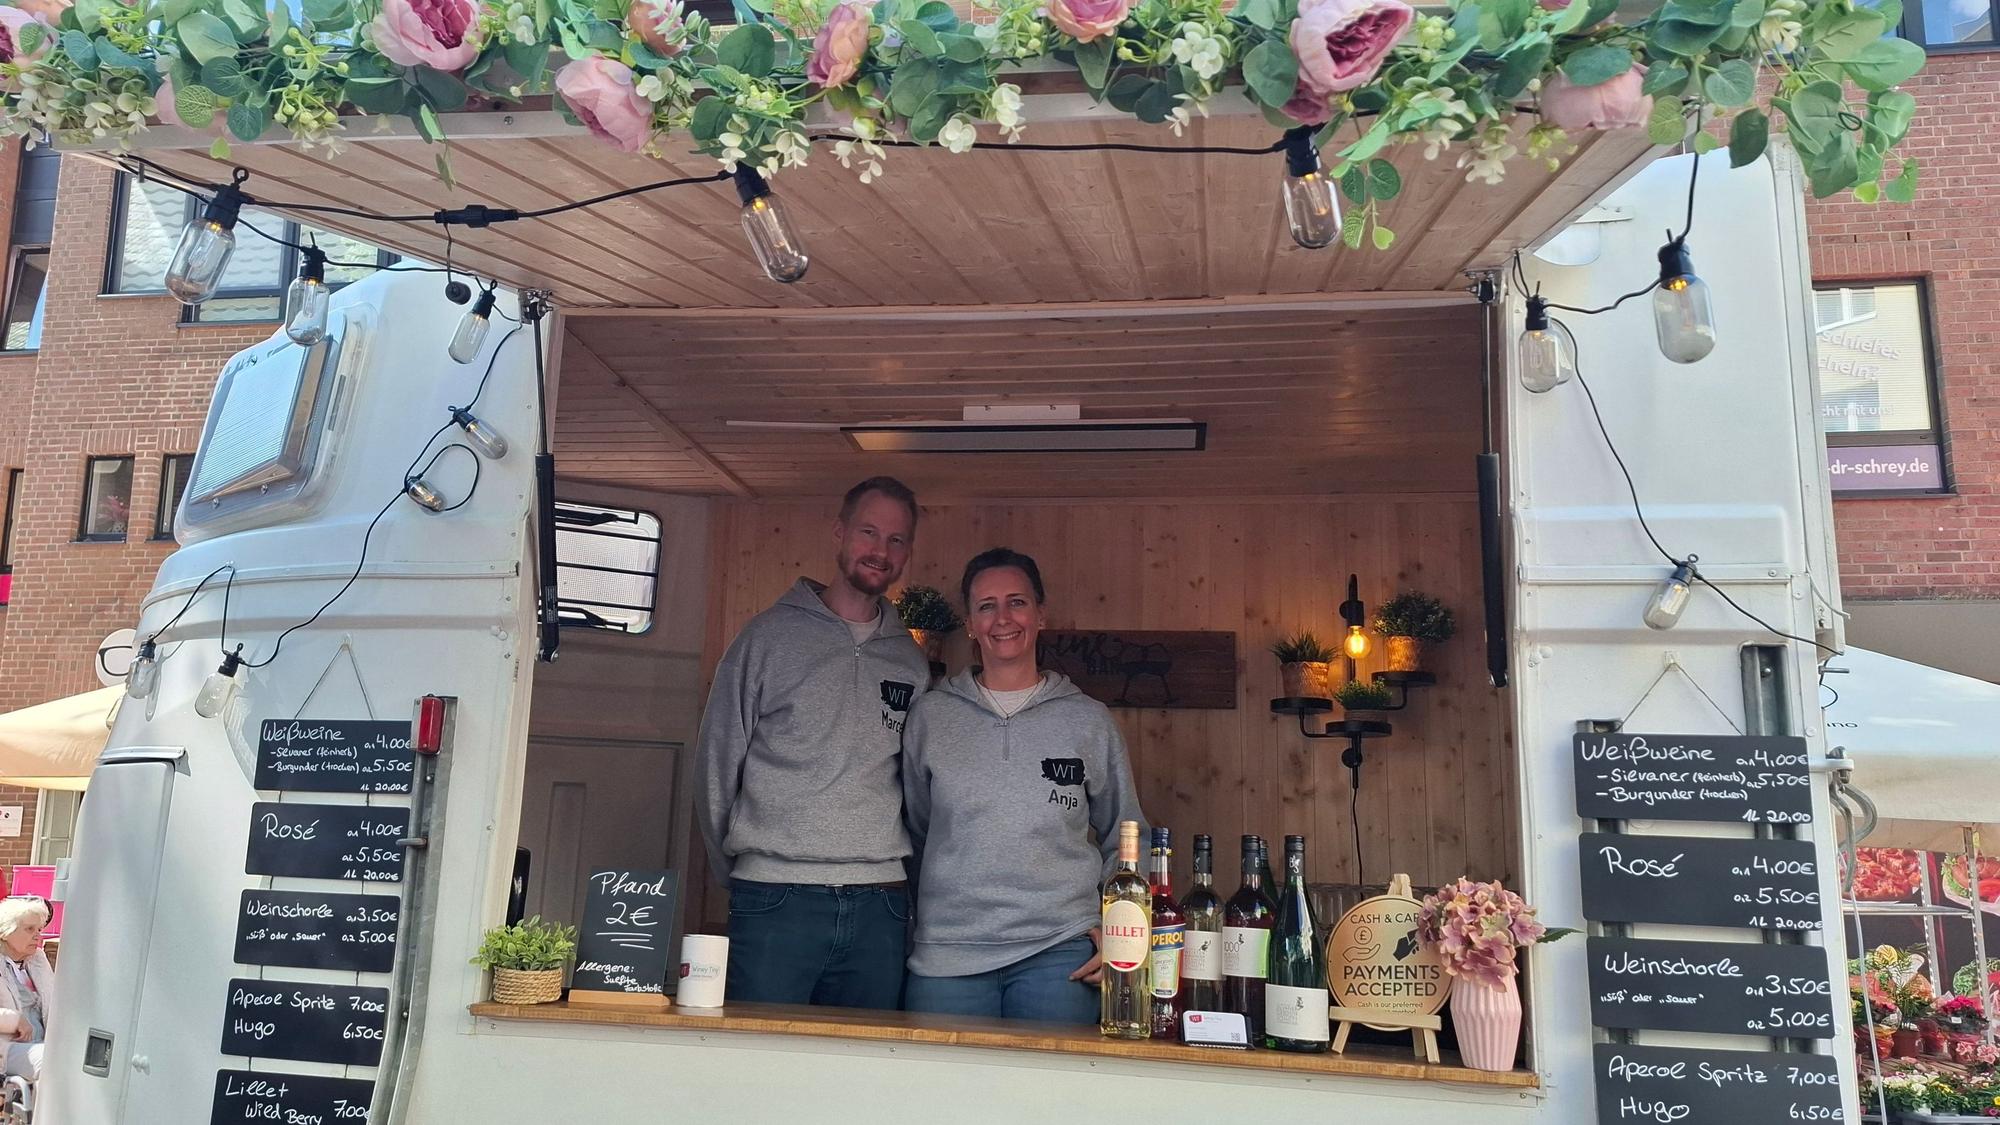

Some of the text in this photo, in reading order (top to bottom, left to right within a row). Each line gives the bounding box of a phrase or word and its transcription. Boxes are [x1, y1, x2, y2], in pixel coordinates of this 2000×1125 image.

[1822, 405, 1840, 416] cht
[888, 686, 906, 705] WT
[881, 709, 903, 734] Marce
[263, 721, 345, 746] Weißweine
[376, 734, 411, 750] 4,00€
[1580, 736, 1716, 765] Weißweine
[1755, 749, 1808, 768] 4,00€
[373, 759, 413, 772] 5,50€
[1052, 763, 1076, 780] WT
[375, 783, 408, 792] 20,00€
[1610, 768, 1690, 784] Silvaner
[1758, 772, 1810, 788] 5,50€
[1048, 789, 1078, 810] Anja
[1609, 786, 1695, 806] Burgunder
[261, 812, 320, 840] Rosé
[360, 820, 403, 836] 4,00€
[1766, 809, 1812, 823] 20,00
[356, 847, 400, 863] 5,50€
[1599, 846, 1685, 877] Rosé
[1753, 855, 1816, 875] 4,00€
[363, 869, 399, 881] 20,00€
[590, 872, 667, 896] Pfand
[1755, 887, 1820, 905] 5,50€
[246, 900, 334, 918] Weinschorle
[357, 907, 398, 922] 3,50€
[605, 901, 658, 926] 2€
[1350, 913, 1419, 924] CASH & CAR
[1105, 925, 1145, 938] LILLET
[1775, 917, 1823, 930] 20,00€
[270, 931, 288, 940] oder
[358, 930, 396, 943] 5,00€
[1152, 931, 1183, 946] PEROL
[576, 960, 635, 975] Allergene:
[1343, 965, 1440, 980] PAYMENTS
[1604, 951, 1743, 977] Weinschorle
[1344, 982, 1438, 997] ACCEPTED
[1765, 974, 1831, 996] 3,50€
[232, 988, 385, 1013] Aperol Spritz 7,00€
[1392, 1001, 1423, 1009] preferred
[1632, 993, 1652, 1003] oder
[1768, 1007, 1830, 1028] 5,00€
[234, 1018, 384, 1040] Hugo 6,50€
[1608, 1055, 1840, 1087] Aperol Spritz 7,00€
[225, 1075, 289, 1098] Lillet
[245, 1101, 282, 1121] Wild
[284, 1108, 323, 1125] Berry
[1620, 1096, 1843, 1123] Hugo 6,50€
